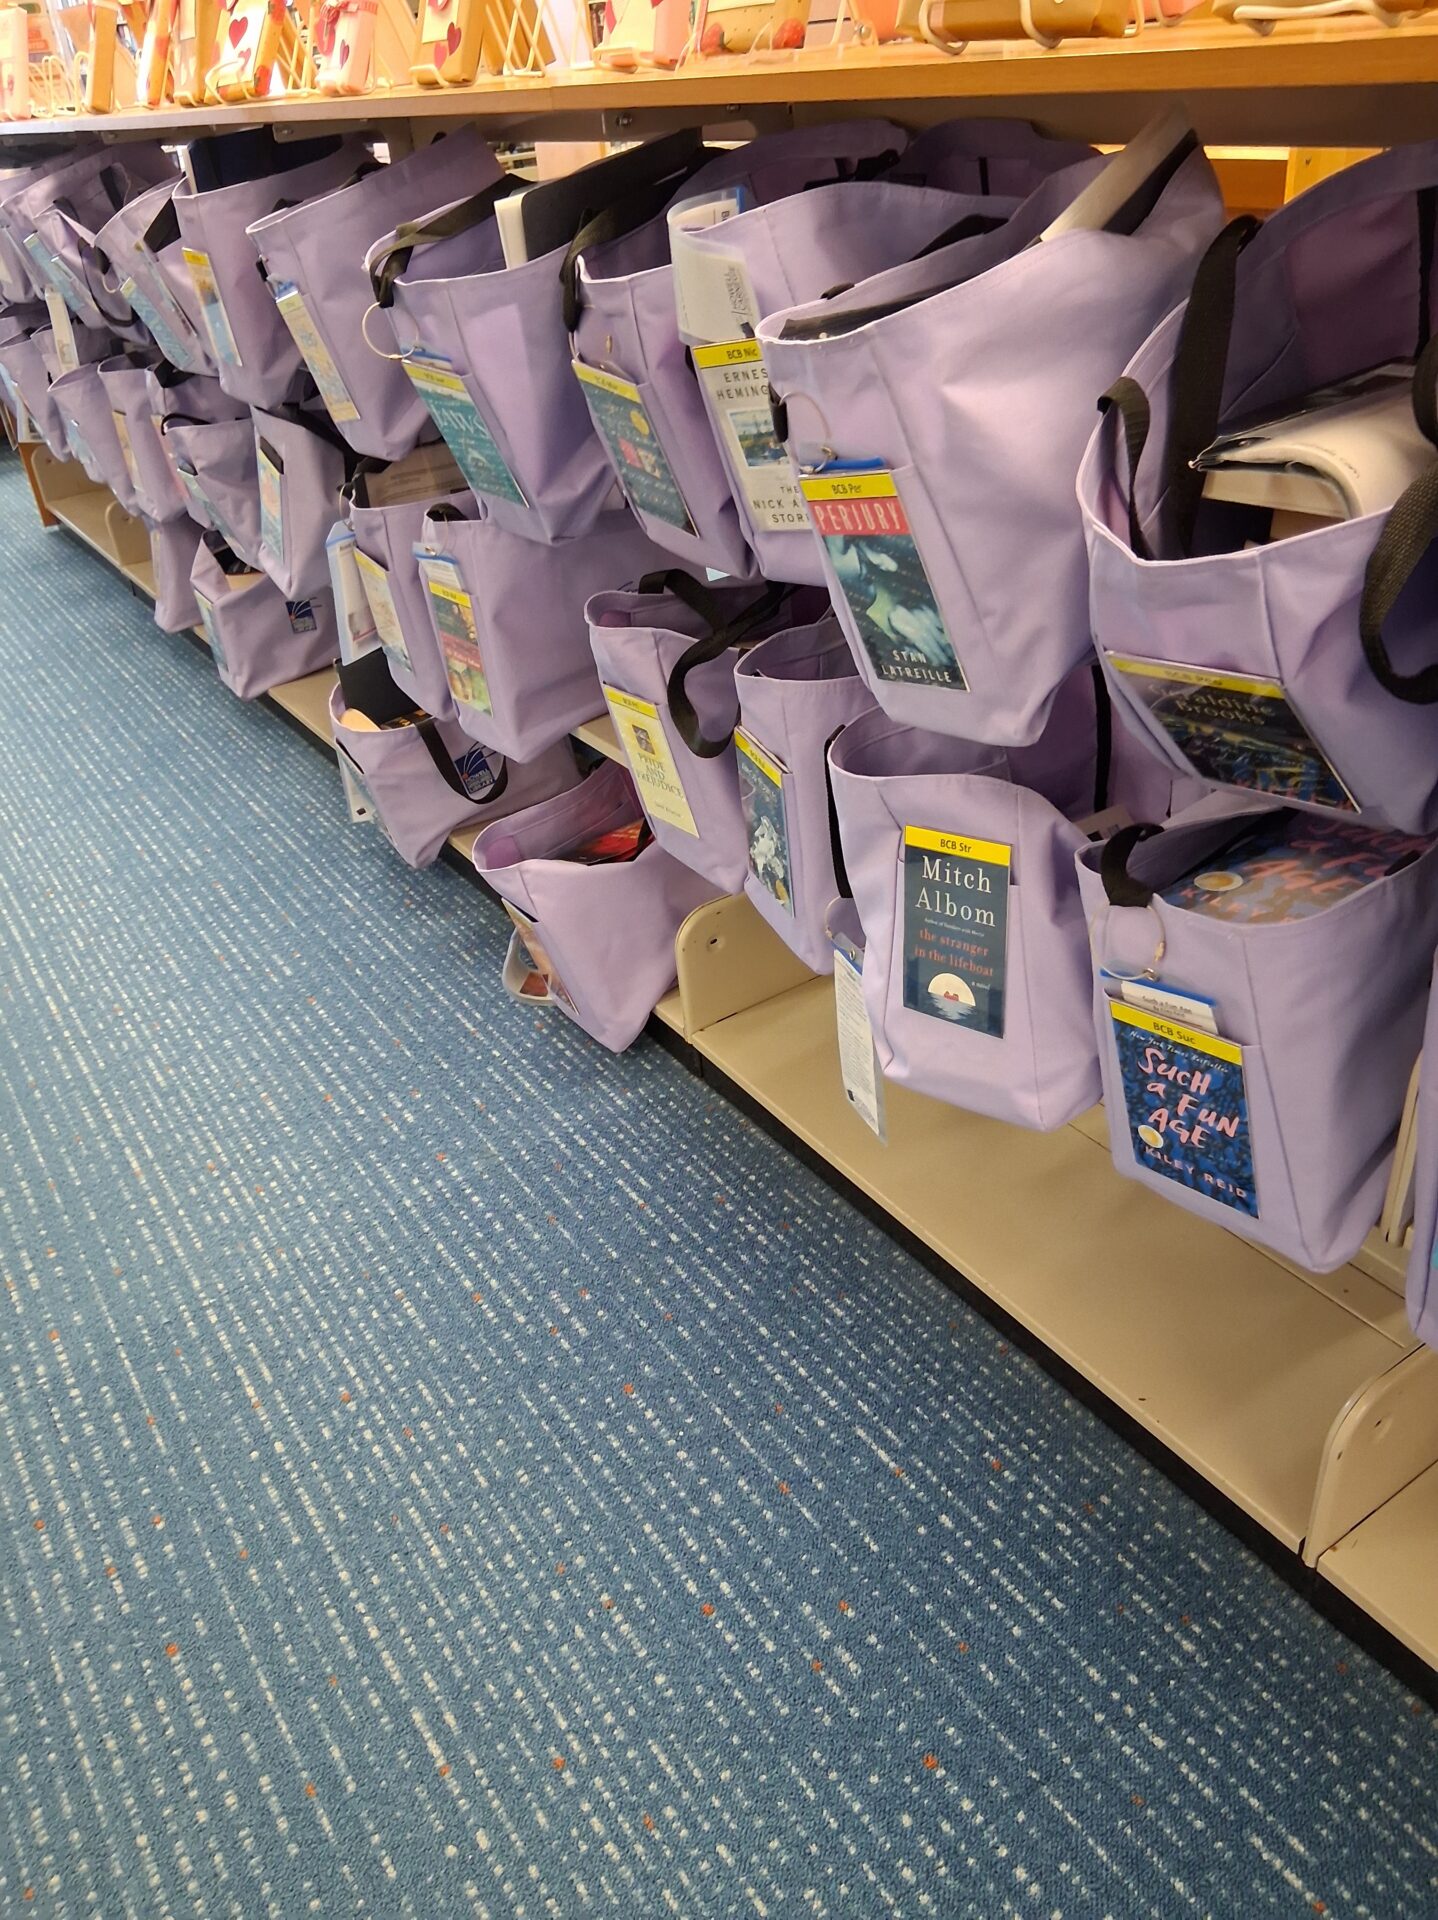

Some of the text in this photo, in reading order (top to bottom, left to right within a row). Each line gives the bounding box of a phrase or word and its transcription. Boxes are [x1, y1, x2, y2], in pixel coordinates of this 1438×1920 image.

[727, 349, 743, 360] BCB
[780, 486, 800, 494] THE
[832, 483, 863, 495] BCB Per
[752, 499, 785, 510] NICK
[814, 502, 901, 531] PERJURY
[893, 649, 927, 664] STAN
[881, 664, 952, 683] LATREILLE
[940, 839, 972, 854] BCB Str
[922, 855, 992, 894] Mitch
[915, 886, 996, 927] Albom
[920, 928, 989, 956] the stranger
[914, 944, 993, 977] in the lifeboat
[1130, 1030, 1146, 1041] New
[1148, 1038, 1164, 1049] York
[1166, 1045, 1189, 1058] Times
[1153, 1022, 1197, 1045] BCB Suc
[1148, 1107, 1211, 1149] AGE
[1203, 1172, 1247, 1198] REID
